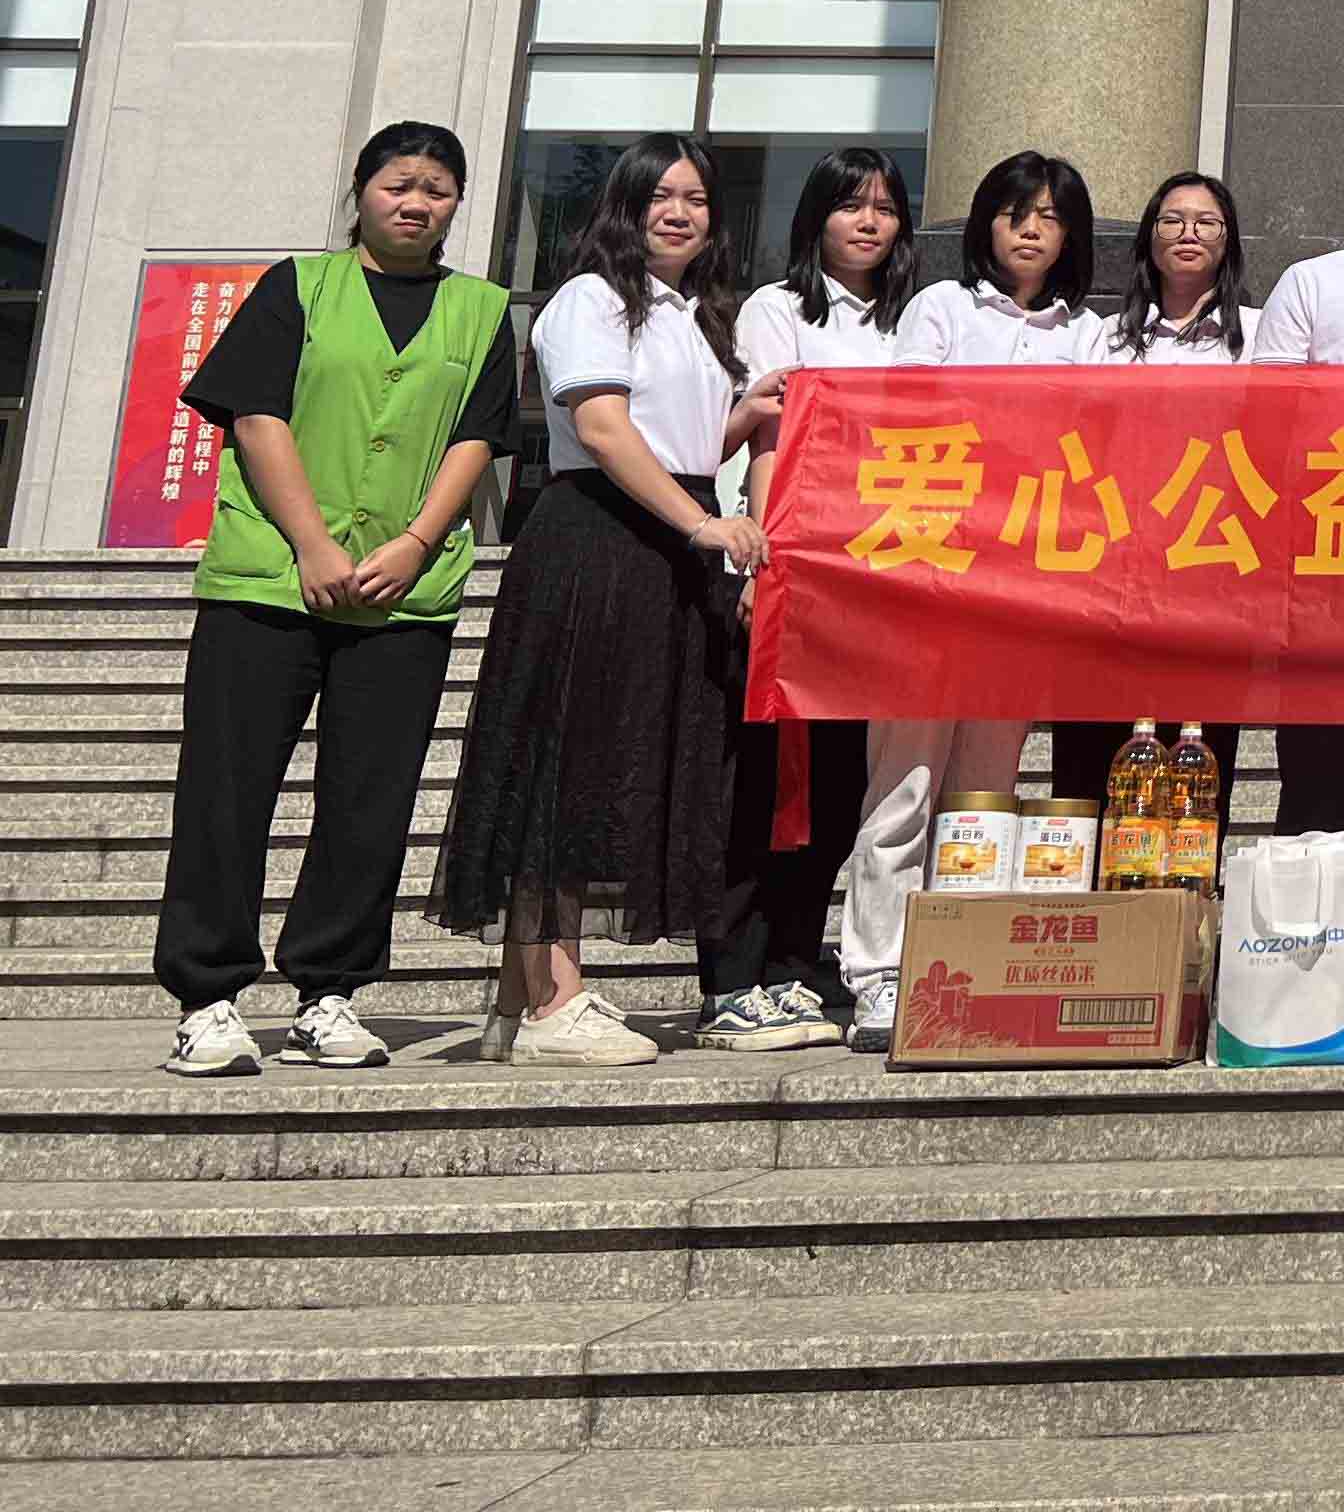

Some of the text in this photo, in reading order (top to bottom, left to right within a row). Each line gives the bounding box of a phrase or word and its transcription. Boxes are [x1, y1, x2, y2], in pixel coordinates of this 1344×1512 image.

[1009, 914, 1099, 944] 金龙鱼
[1238, 937, 1308, 953] AOZON
[1006, 963, 1096, 985] 优质丝苗米
